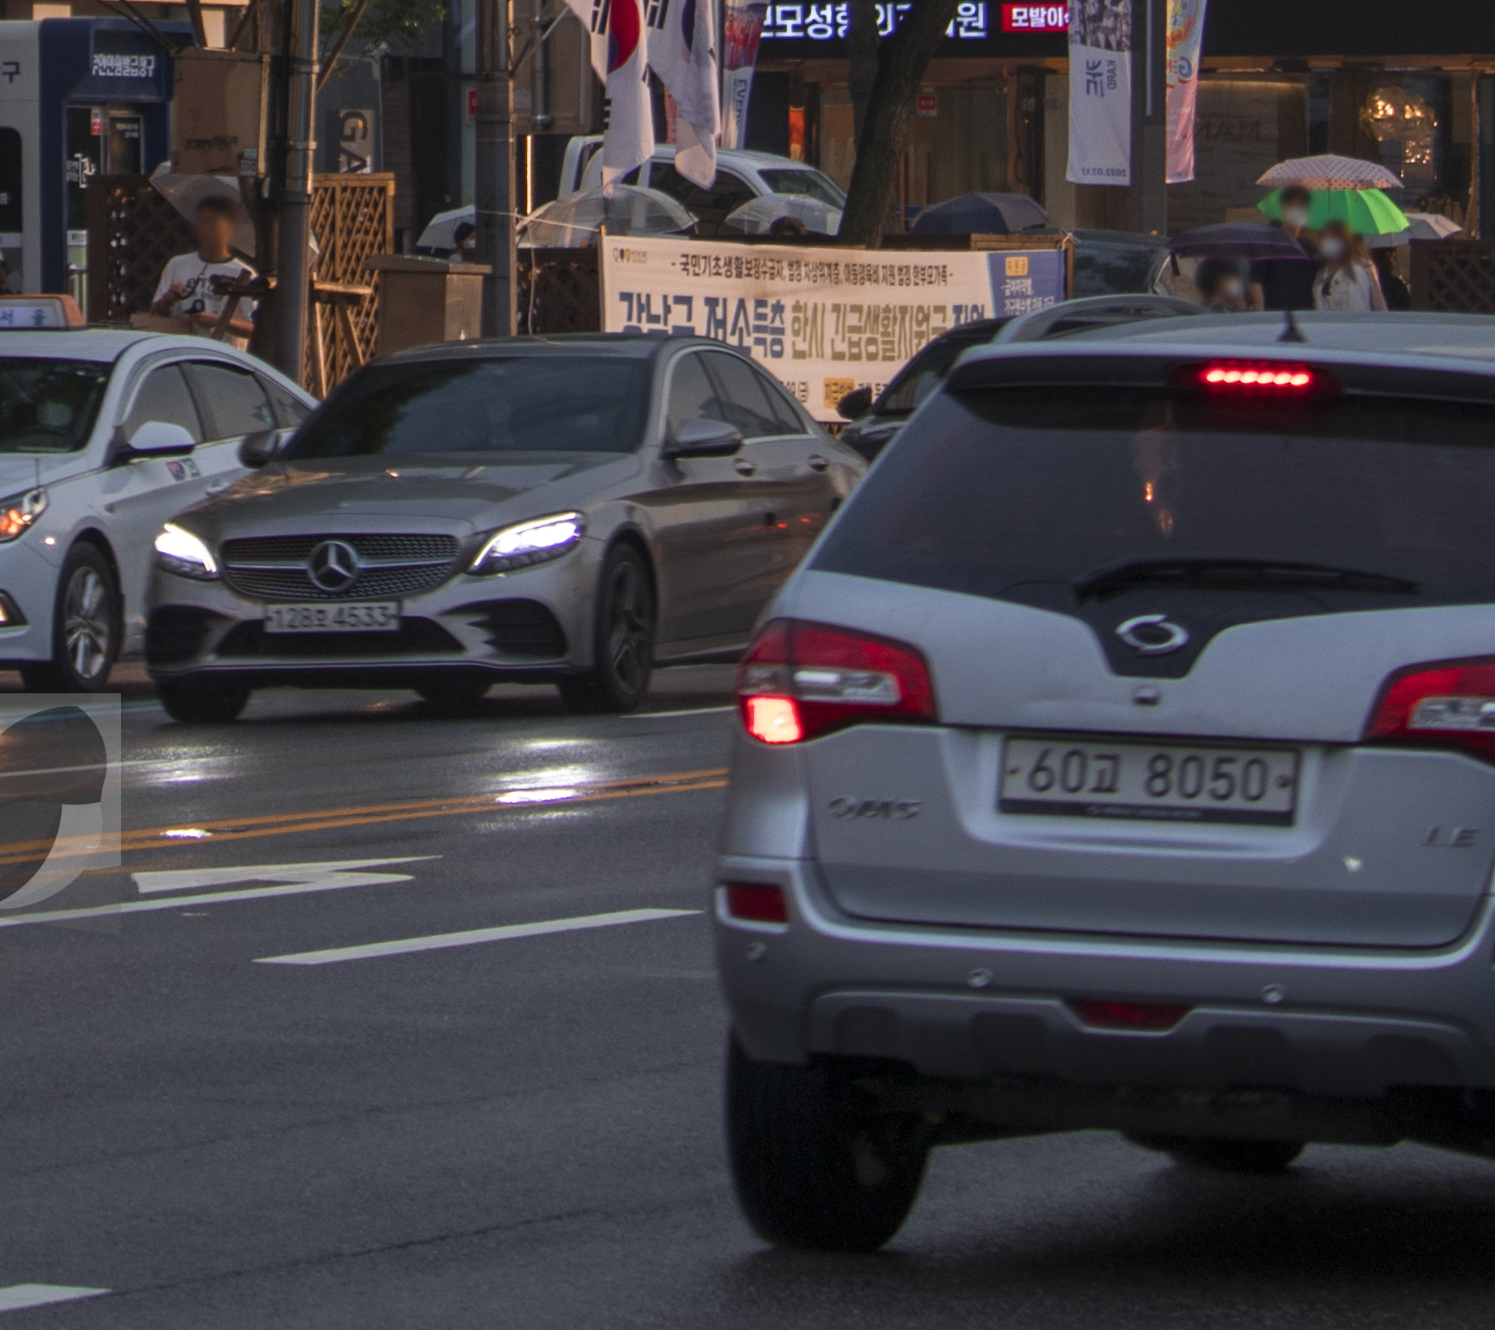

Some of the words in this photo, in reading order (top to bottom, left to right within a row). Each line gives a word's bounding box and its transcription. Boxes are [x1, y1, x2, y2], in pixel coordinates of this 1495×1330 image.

[1010, 5, 1068, 30] 모발이
[1026, 745, 1118, 795] 60고
[1143, 751, 1266, 803] 8050
[825, 794, 922, 821] QM5
